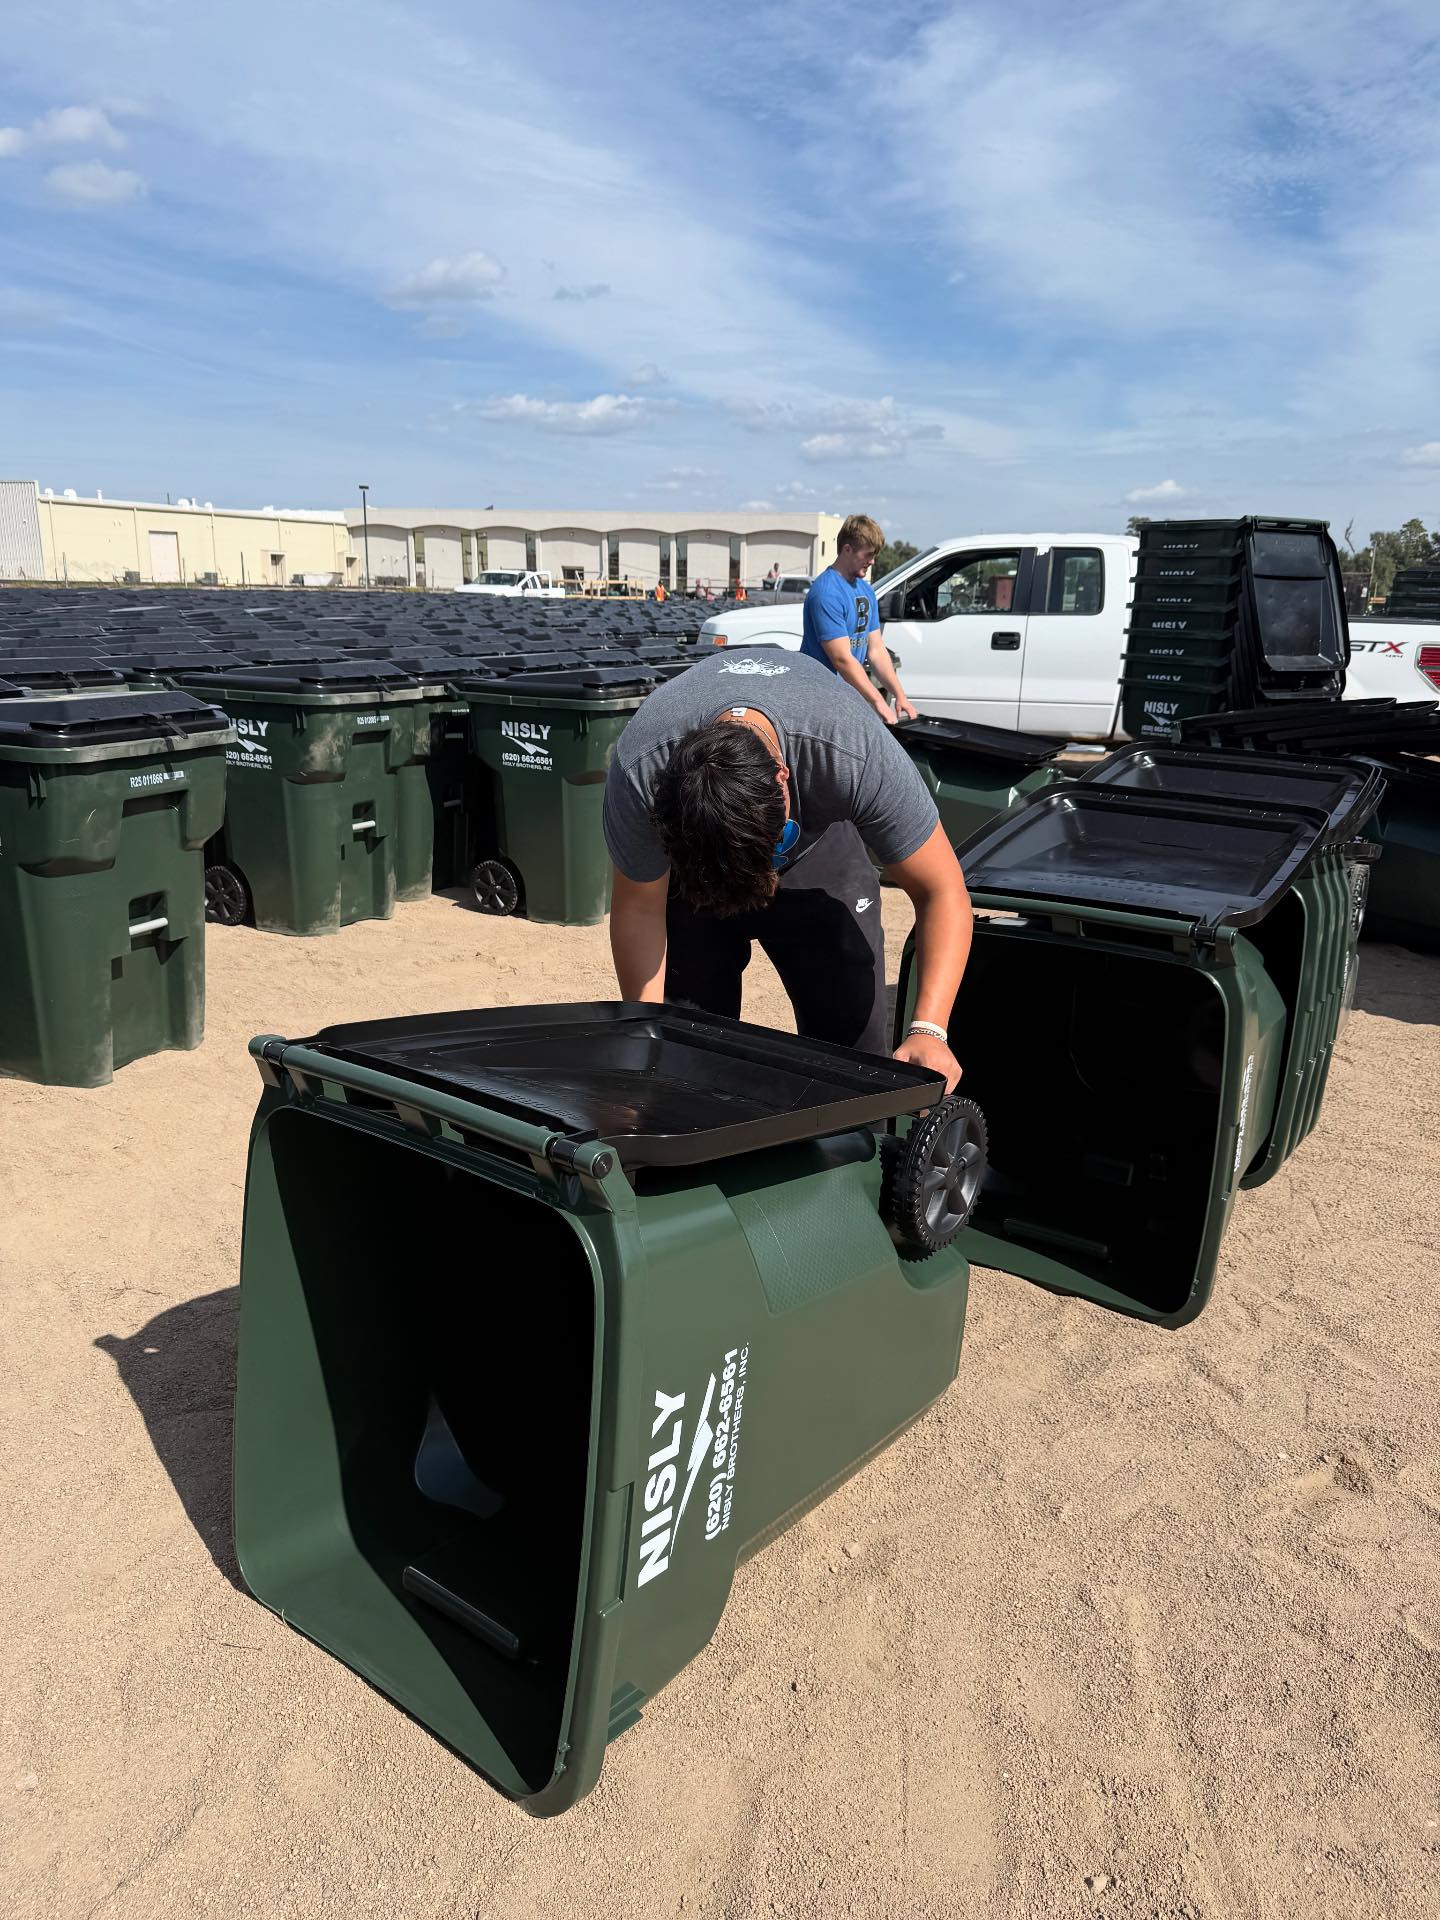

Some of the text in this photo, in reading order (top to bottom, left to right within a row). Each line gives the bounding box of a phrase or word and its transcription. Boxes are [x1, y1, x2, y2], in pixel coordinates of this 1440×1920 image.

[854, 596, 870, 634] B
[501, 720, 551, 740] NISLY
[1144, 701, 1179, 715] NISLY
[637, 1389, 686, 1588] NISLY
[704, 1348, 738, 1541] (620) 662-6561
[721, 1342, 750, 1531] NISLY BROTHERS, INC.
